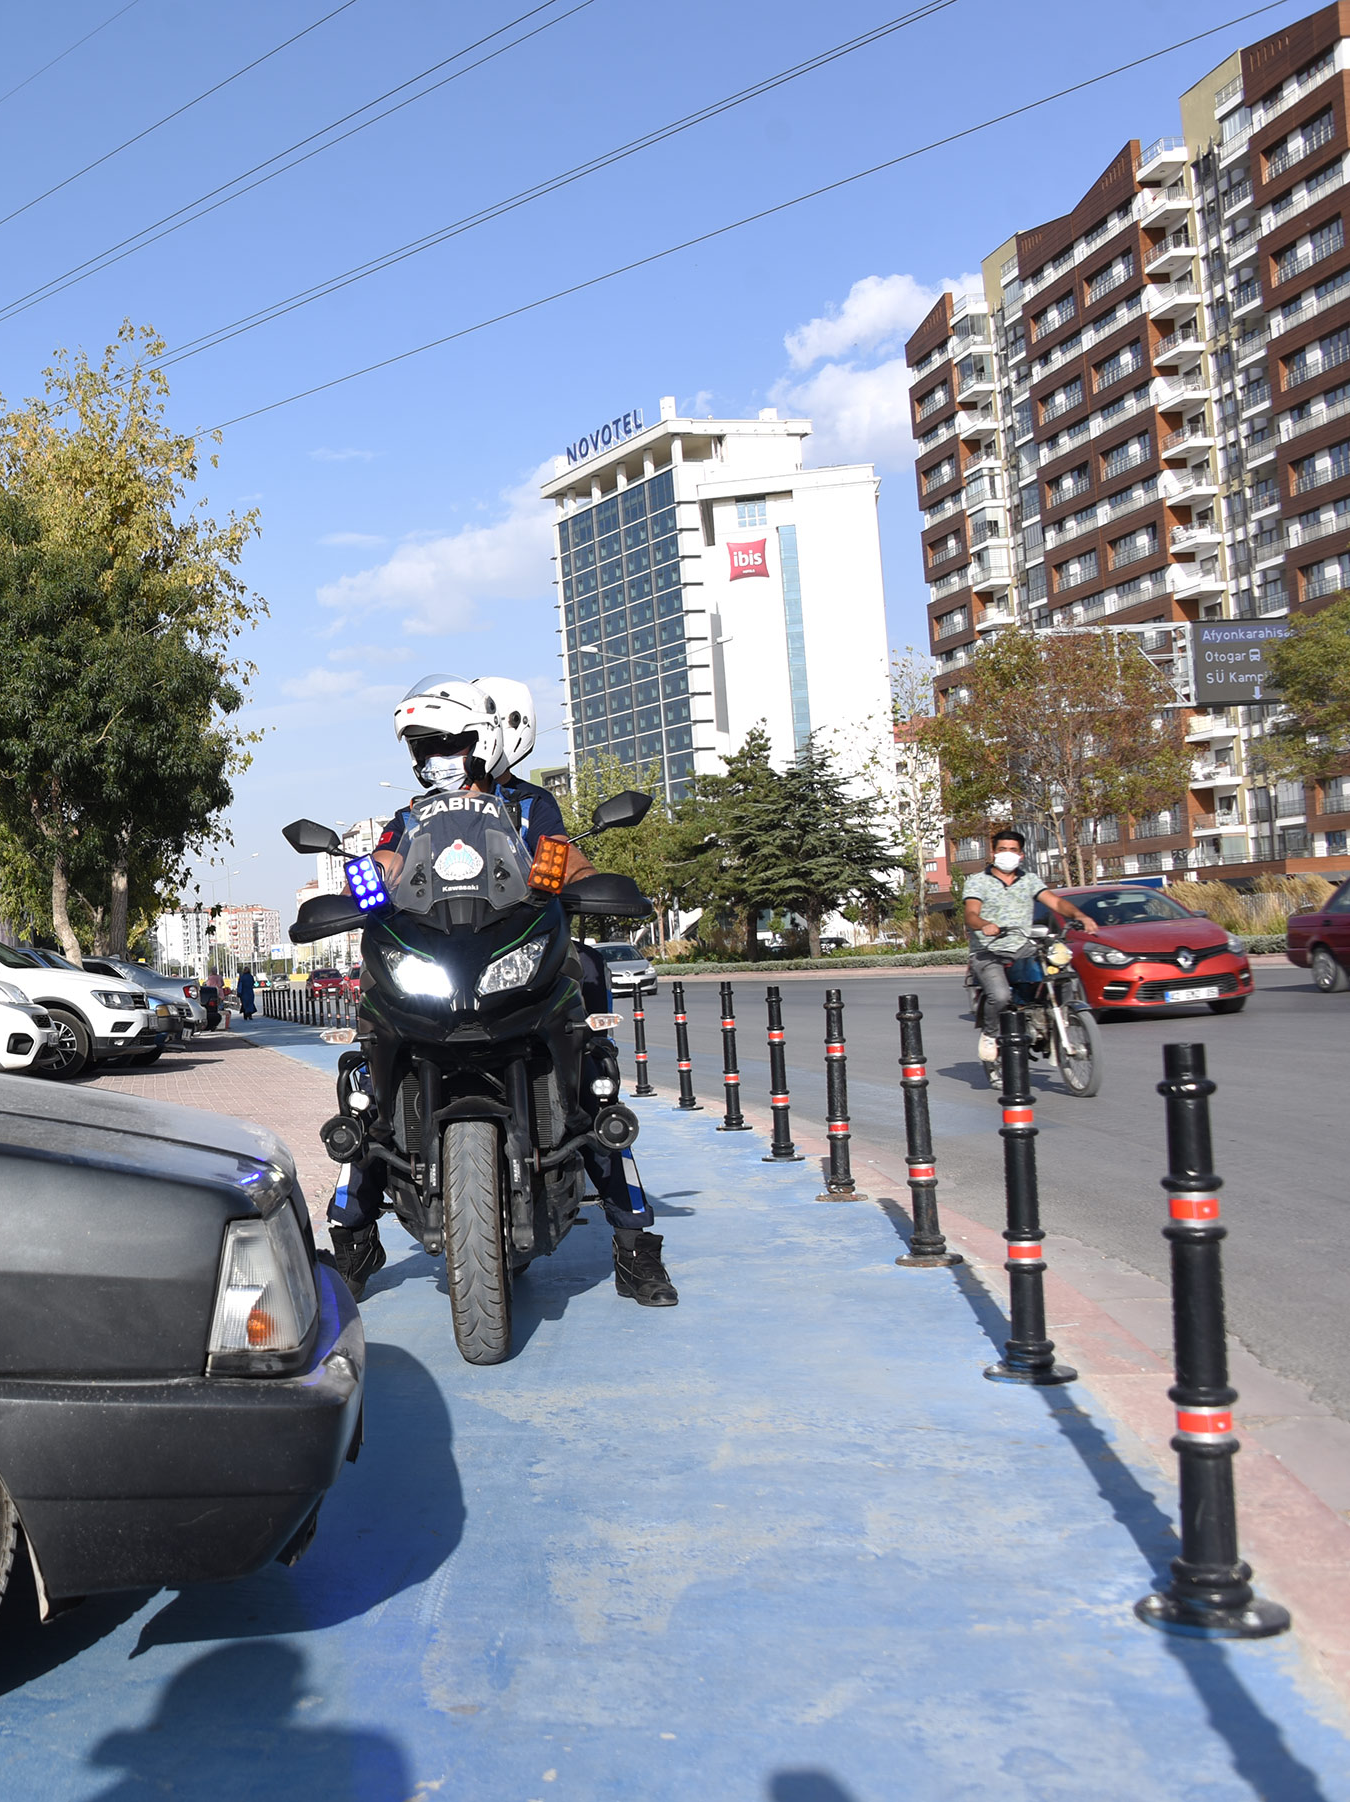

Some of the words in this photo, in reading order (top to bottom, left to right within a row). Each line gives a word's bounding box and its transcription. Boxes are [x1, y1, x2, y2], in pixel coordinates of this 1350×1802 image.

[566, 409, 642, 465] NOVOTEL
[733, 549, 763, 568] ibis
[1205, 650, 1247, 664] Otogar
[1206, 669, 1225, 684] SÜ
[1229, 671, 1272, 685] Kamp
[419, 797, 499, 821] ZABITA
[442, 884, 479, 893] Kawasaki
